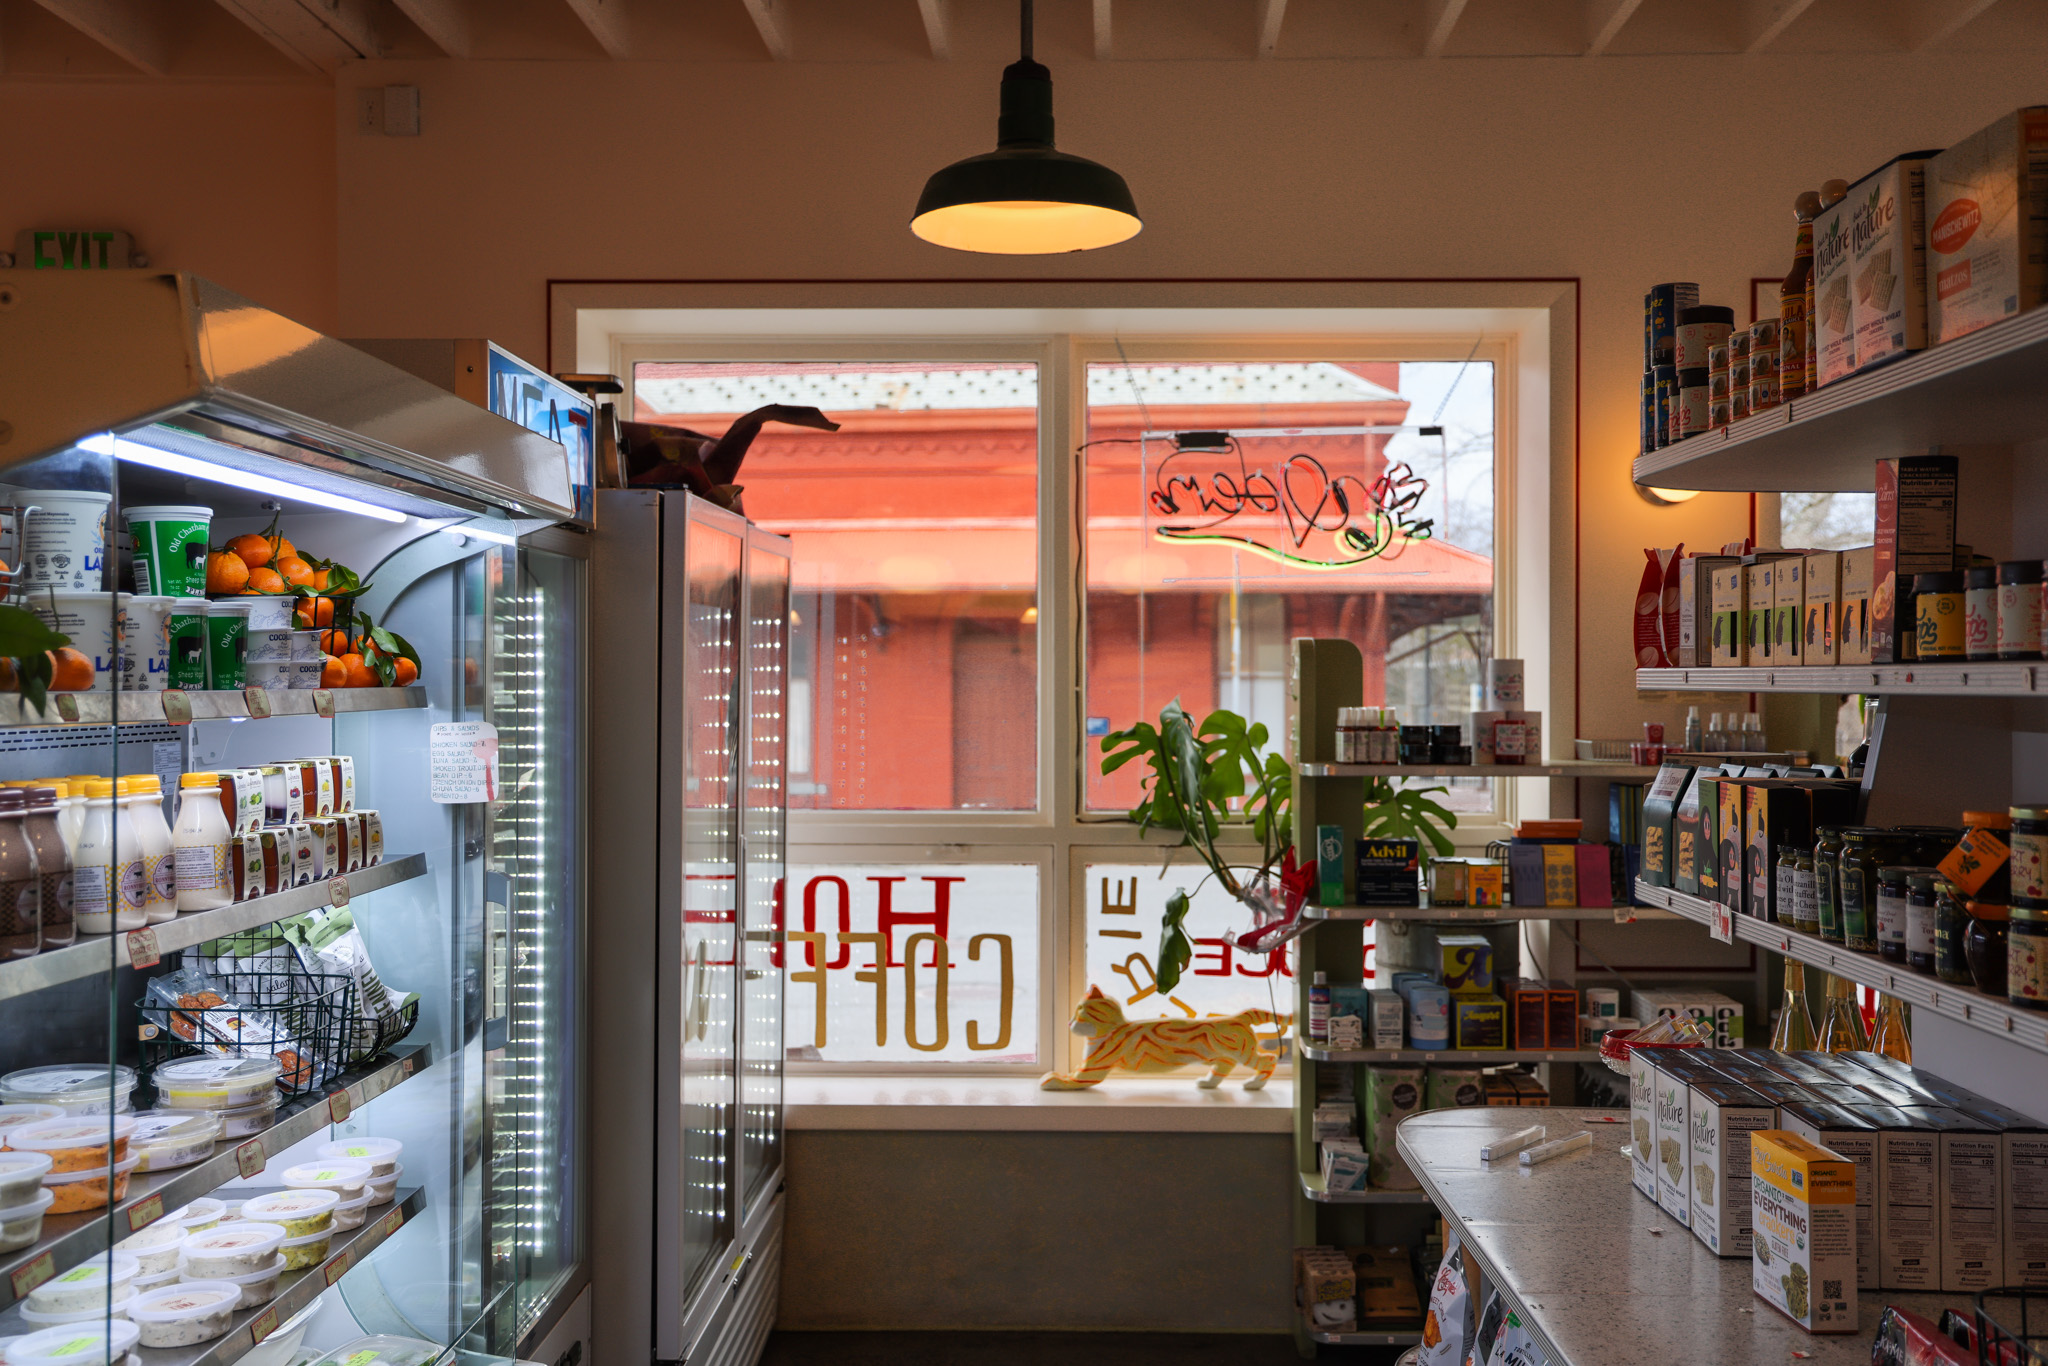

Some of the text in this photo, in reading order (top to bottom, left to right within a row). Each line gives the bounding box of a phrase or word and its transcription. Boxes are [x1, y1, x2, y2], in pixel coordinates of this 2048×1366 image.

[1932, 208, 1979, 245] MANISCHEWITZ
[34, 231, 114, 270] EXIT
[169, 538, 181, 553] Old
[221, 634, 232, 648] Old
[1366, 845, 1407, 858] Advil
[1658, 1100, 1683, 1124] nature
[1692, 1120, 1716, 1146] nature
[1753, 1176, 1782, 1203] ORGANIC
[1754, 1190, 1807, 1234] EVERYTHING
[1759, 1211, 1796, 1245] crackers
